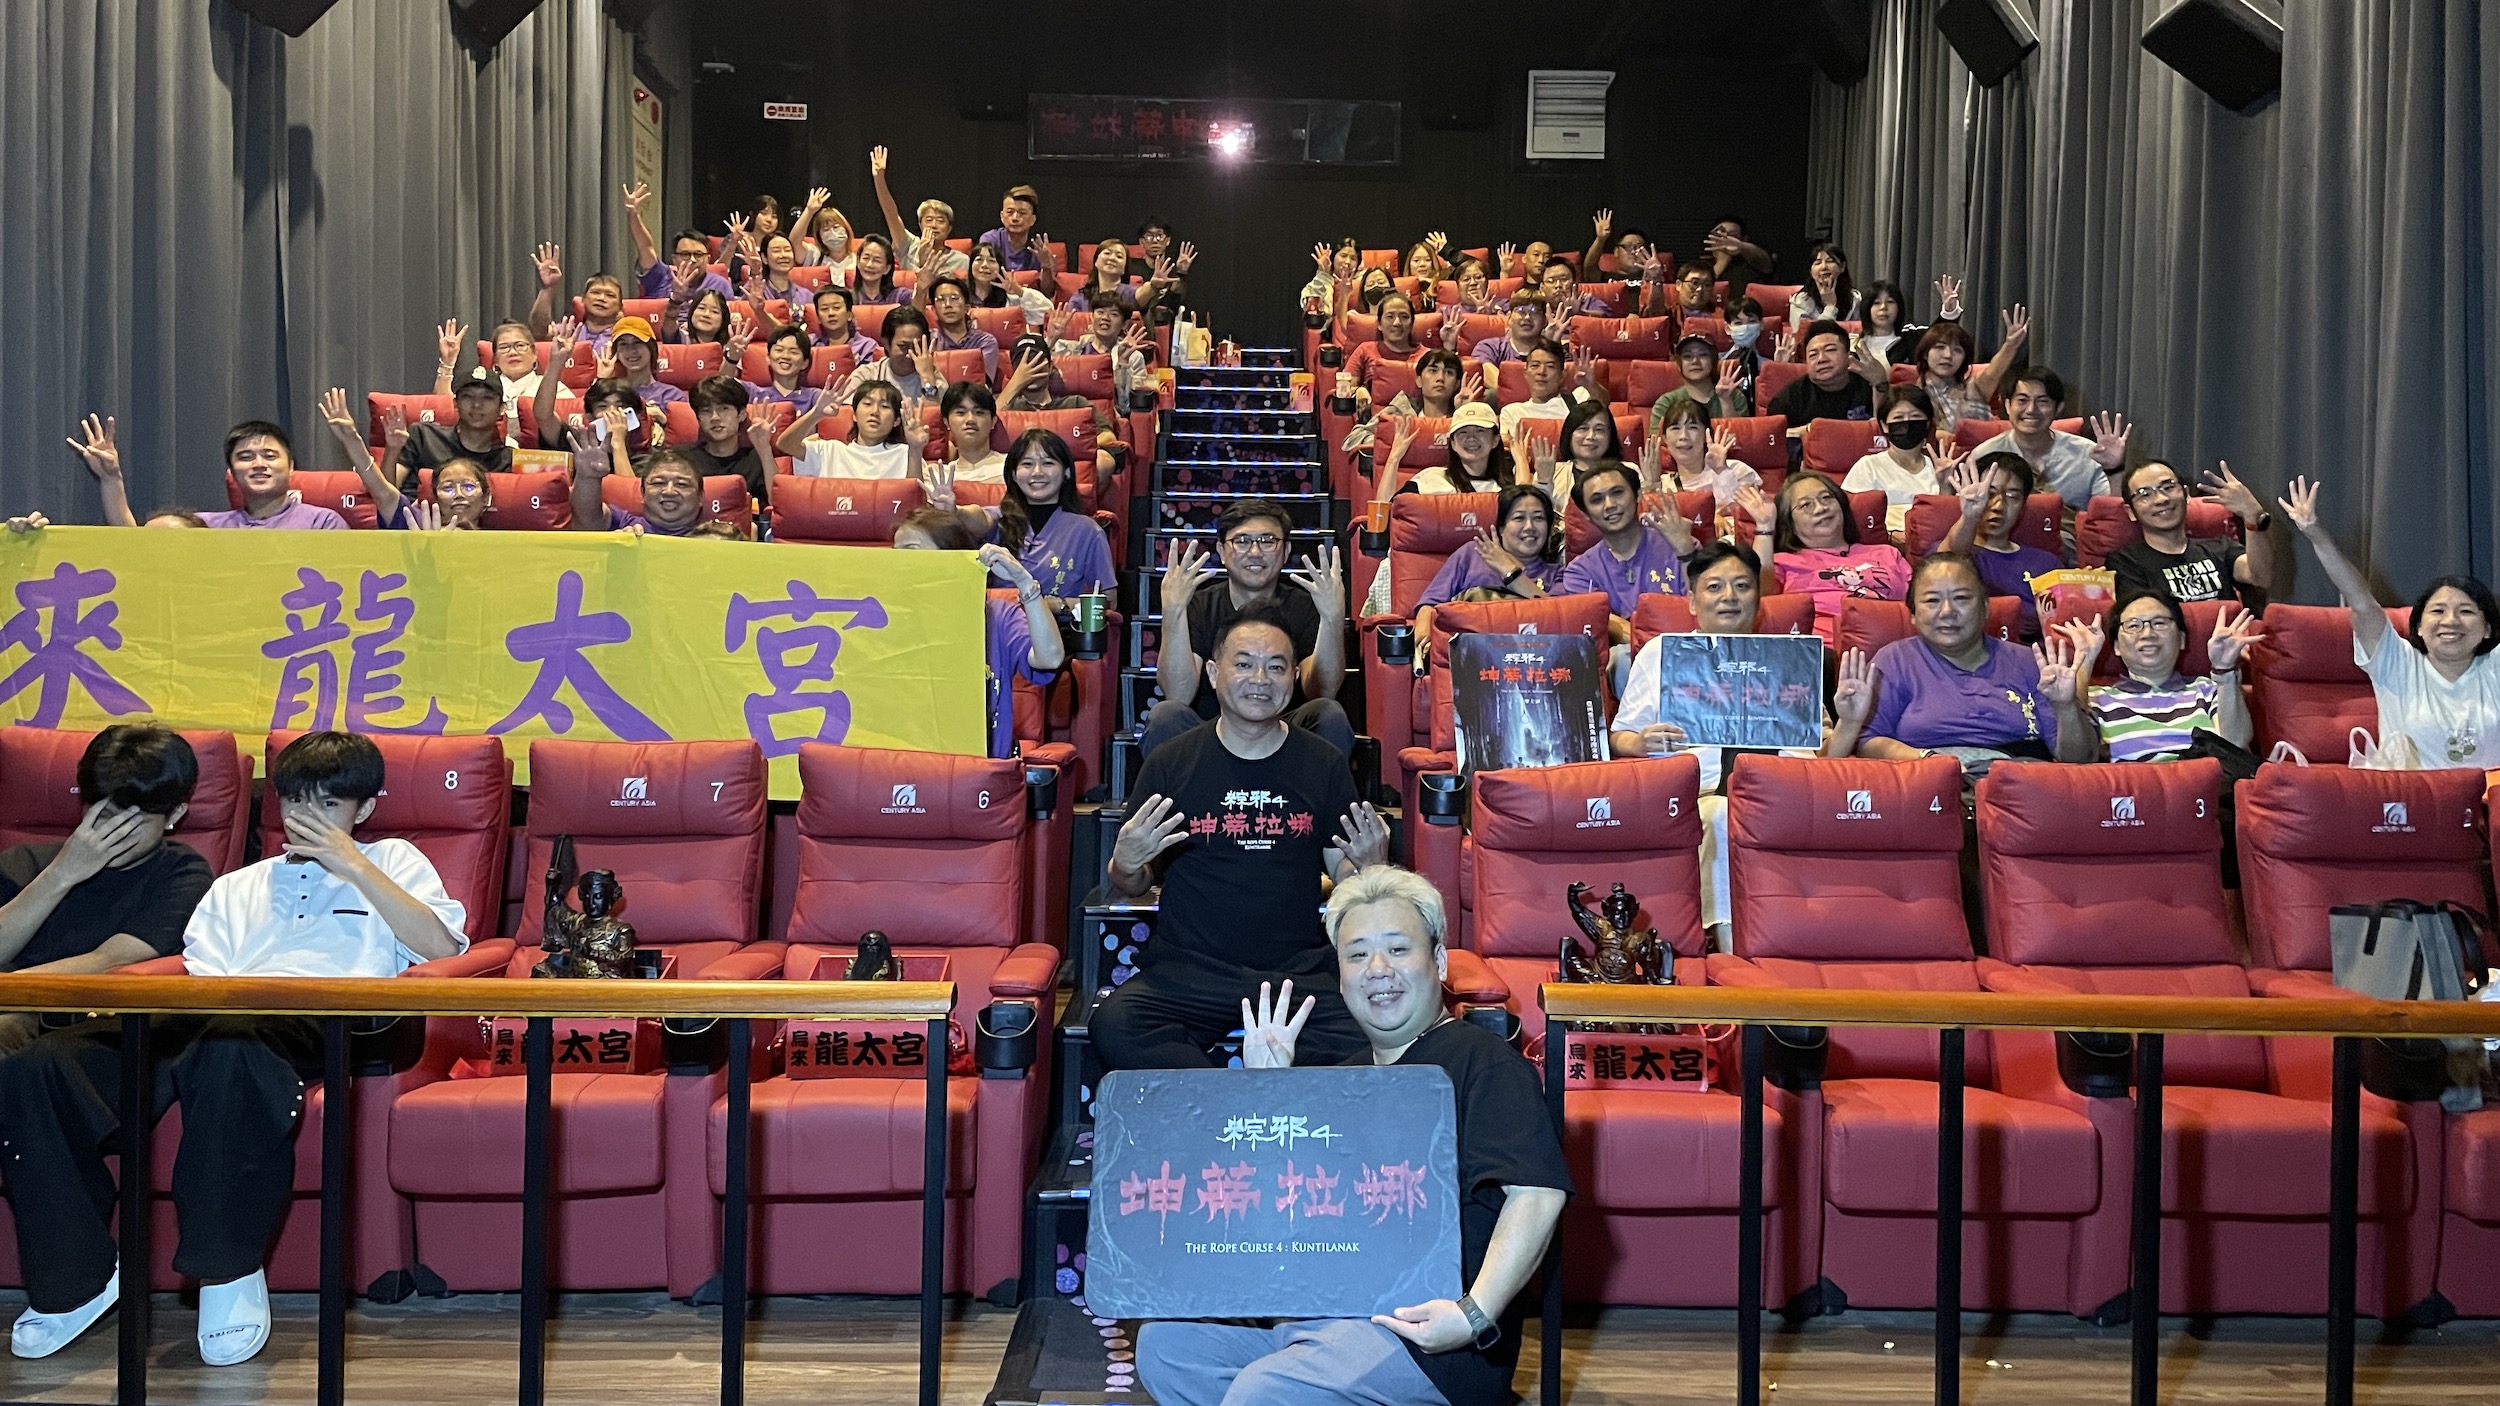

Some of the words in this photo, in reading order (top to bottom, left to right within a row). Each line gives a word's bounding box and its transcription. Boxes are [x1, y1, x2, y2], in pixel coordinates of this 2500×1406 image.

[649, 313, 658, 323] 10
[1003, 321, 1009, 330] 7
[1654, 331, 1659, 340] 3
[697, 360, 704, 369] 9
[829, 361, 835, 371] 8
[962, 366, 968, 376] 7
[1091, 370, 1098, 380] 6
[1072, 426, 1080, 437] 6
[1624, 435, 1631, 446] 4
[1769, 434, 1775, 446] 3
[340, 494, 355, 508] 10
[531, 496, 540, 509] 9
[711, 499, 720, 513] 8
[892, 500, 901, 514] 7
[1693, 512, 1703, 526] 4
[1867, 515, 1874, 529] 3
[2043, 518, 2052, 531] 2
[1583, 624, 1592, 636] 5
[1789, 622, 1800, 635] 4
[2000, 625, 2008, 641] 3
[444, 770, 458, 790] 8
[710, 781, 725, 802] 7
[610, 799, 640, 807] CENTURY
[641, 799, 657, 807] ASIA
[977, 790, 990, 810] 6
[1668, 797, 1680, 817] 5
[1929, 795, 1943, 815] 4
[2195, 798, 2206, 818] 3
[1576, 821, 1605, 829] CENTURY
[1606, 819, 1622, 827] ASIA
[2463, 808, 2472, 828] 2
[495, 1028, 514, 1066] 烏來
[791, 1030, 809, 1067] 烏來
[815, 1031, 926, 1066] 龍太宮
[1569, 1042, 1586, 1081] 烏來
[1593, 1045, 1704, 1082] 龍太宮
[1216, 1112, 1343, 1151] 粽邪4
[1119, 1159, 1428, 1240] 坤蒂拉娜
[1185, 1242, 1207, 1254] THE
[1209, 1242, 1237, 1254] ROPE
[1240, 1242, 1274, 1254] CURSE
[1276, 1242, 1282, 1253] 4
[1291, 1241, 1360, 1253] KUNTILANAK
